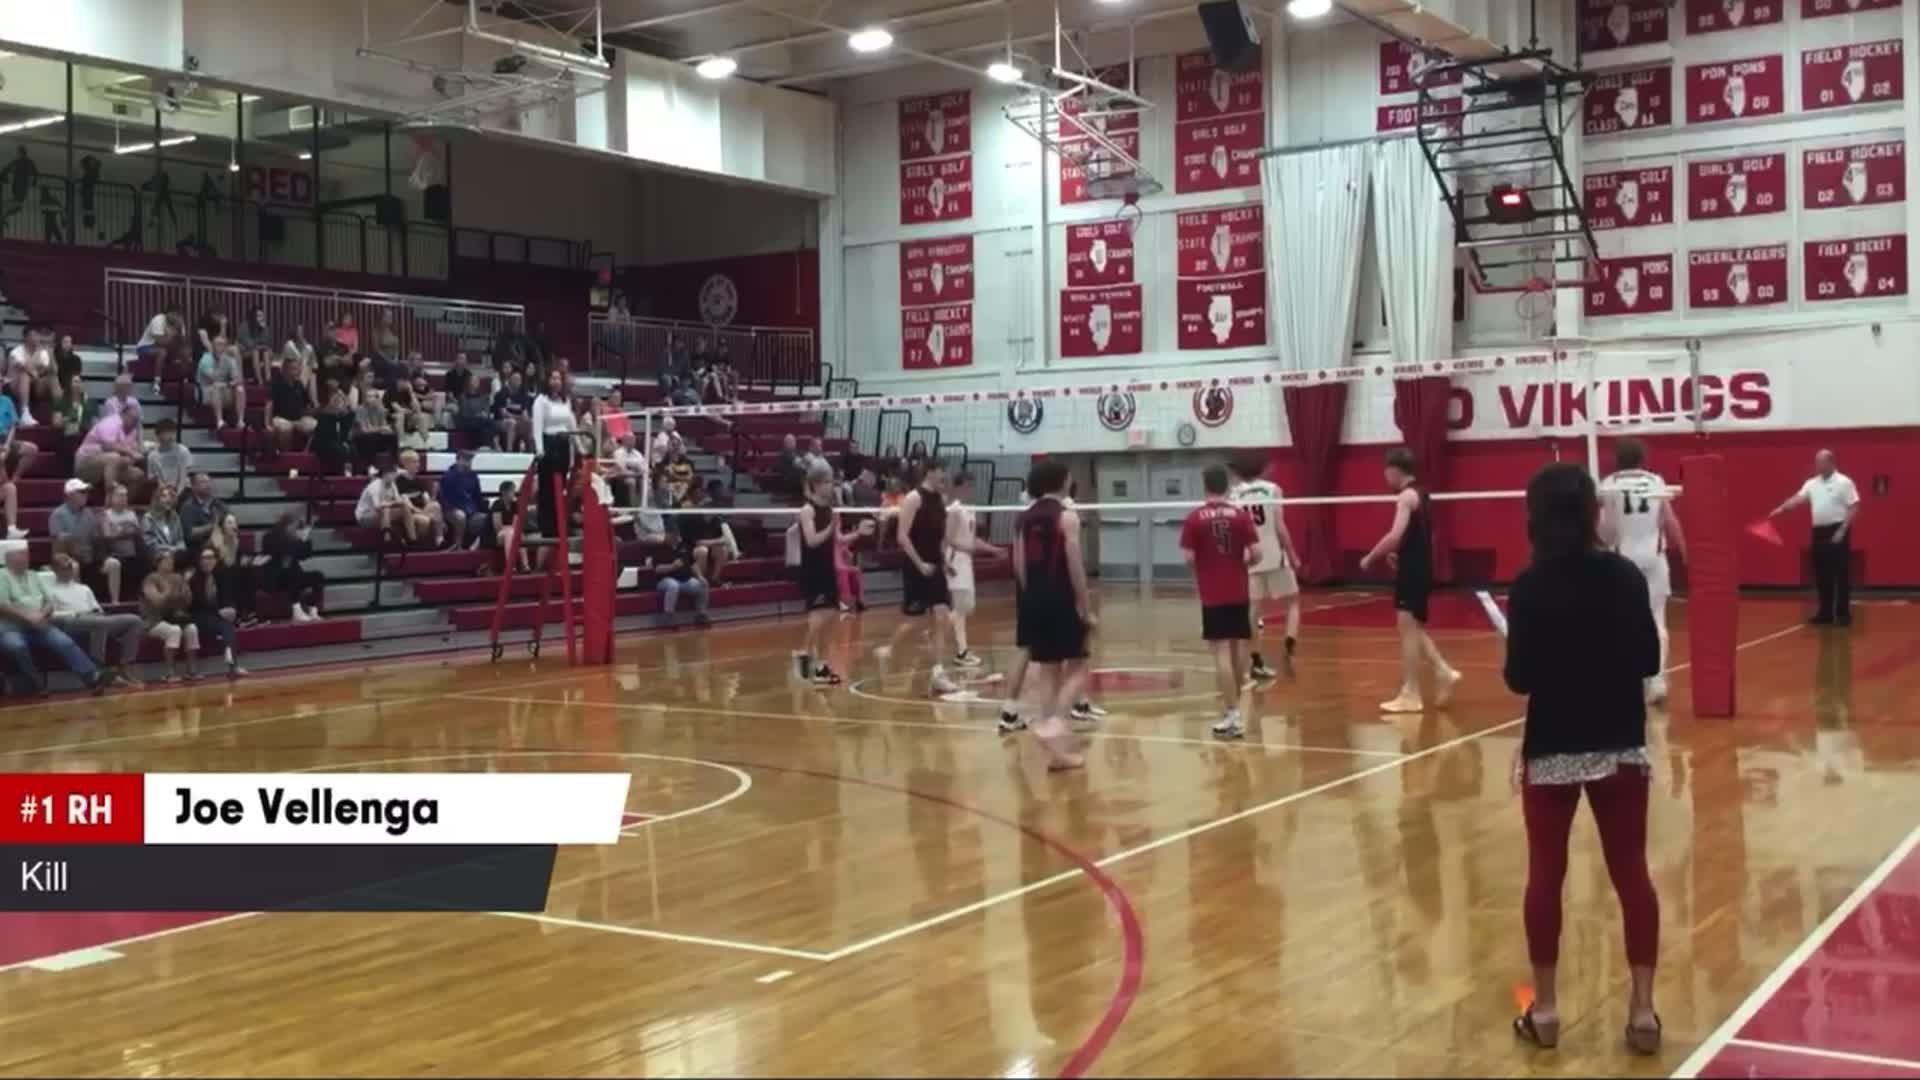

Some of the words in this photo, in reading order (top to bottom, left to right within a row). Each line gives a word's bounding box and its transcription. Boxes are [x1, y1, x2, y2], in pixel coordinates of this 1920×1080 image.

[1805, 48, 1843, 64] FIELD
[1849, 42, 1900, 59] HOCKEY
[1807, 150, 1844, 164] FIELD
[1851, 143, 1903, 160] HOCKEY
[1699, 163, 1734, 177] GIRLS
[1743, 157, 1774, 172] GOLF
[1586, 176, 1617, 191] GIRLS
[1639, 169, 1669, 184] GOLF
[1689, 246, 1787, 265] CHEERLEADERS
[1818, 242, 1848, 257] FIELD
[1854, 239, 1893, 253] HOCKEY
[1499, 372, 1773, 429] VIKINGS
